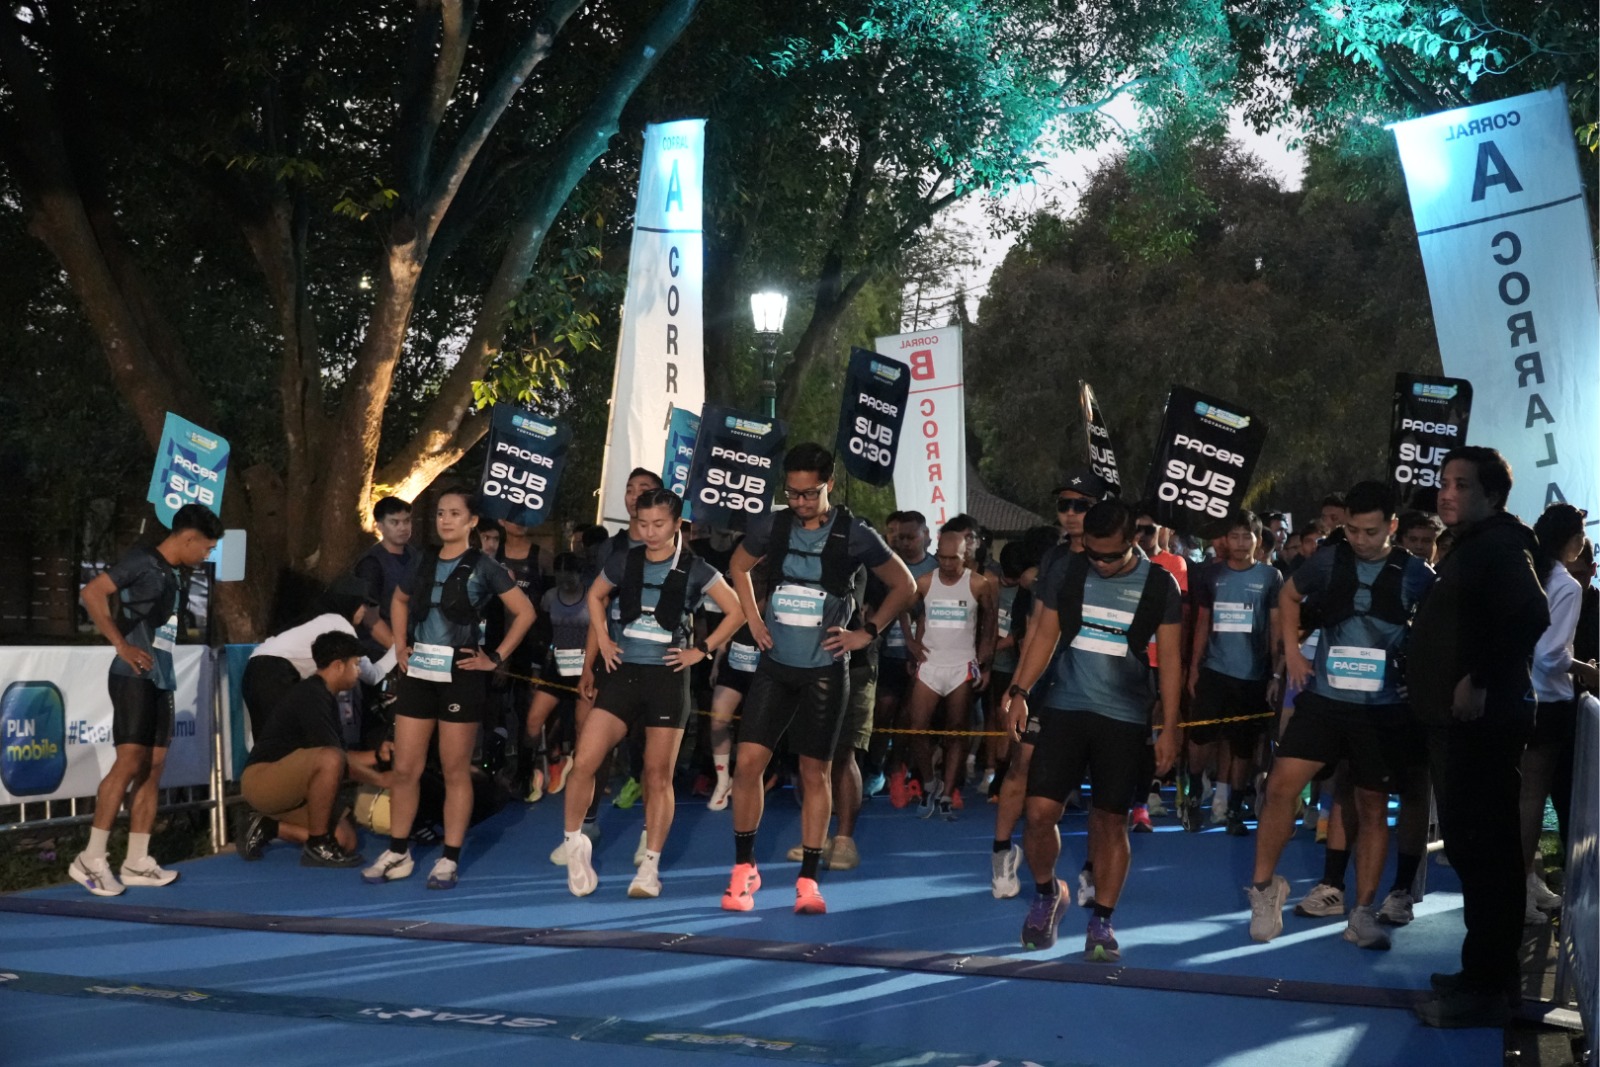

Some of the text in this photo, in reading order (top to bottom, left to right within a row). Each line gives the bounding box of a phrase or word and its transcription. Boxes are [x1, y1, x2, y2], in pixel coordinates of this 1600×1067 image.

[665, 159, 684, 212] A
[1471, 140, 1524, 202] A
[663, 246, 680, 432] CORR
[855, 416, 893, 446] SUB
[1087, 422, 1109, 438] PACE
[1200, 417, 1236, 434] YOGYAKARTA
[849, 437, 891, 467] 0:30
[170, 475, 214, 505] SUB
[490, 462, 547, 492] SUB
[706, 468, 766, 495] SUB
[1166, 459, 1236, 496] SUB
[483, 480, 544, 510] 0:30
[700, 487, 764, 514] 0:30
[1158, 482, 1230, 519] 0:35
[777, 598, 816, 609] PACER
[414, 655, 445, 667] PACER
[1333, 661, 1377, 672] PACER
[7, 719, 36, 738] PLN
[7, 739, 58, 761] mobile
